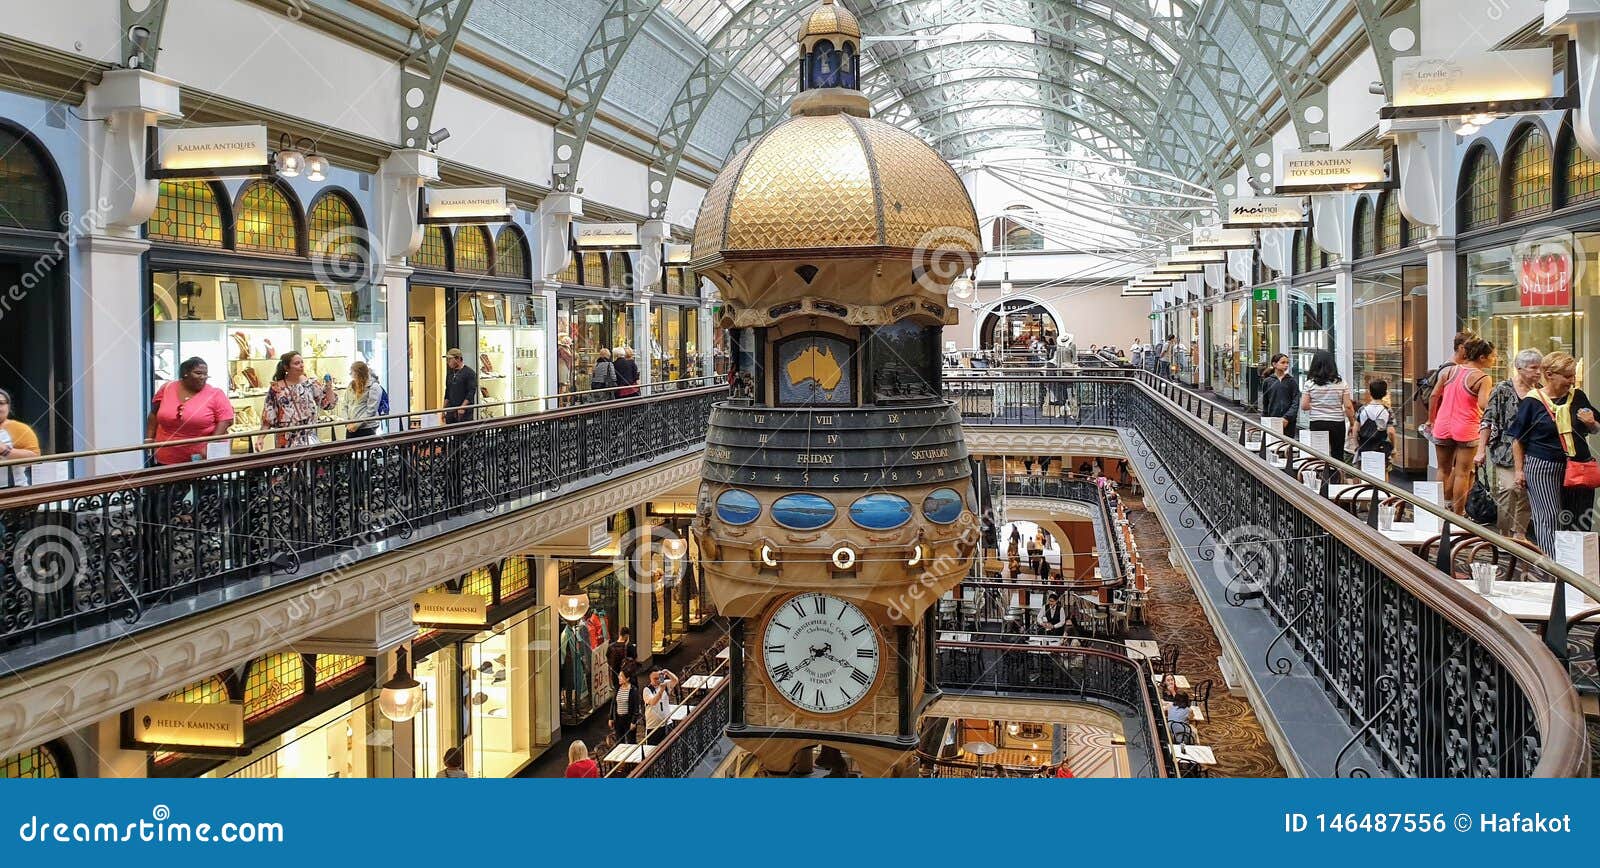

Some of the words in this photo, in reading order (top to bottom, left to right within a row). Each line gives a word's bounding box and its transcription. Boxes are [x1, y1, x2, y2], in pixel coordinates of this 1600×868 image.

[1417, 69, 1448, 79] Lovelle
[177, 144, 212, 153] KALMAR
[212, 141, 256, 151] ANTIQUES
[1289, 159, 1315, 168] PETER
[1315, 158, 1352, 167] NATHAN
[1290, 169, 1308, 177] TOY
[1309, 167, 1351, 176] SOLDIERS
[1522, 271, 1567, 294] SALE
[754, 415, 765, 424] VII
[815, 415, 833, 425] VIII
[827, 434, 838, 443] IV
[797, 454, 834, 464] FRIDAY
[911, 448, 948, 460] SATURDAY
[750, 471, 757, 480] 3
[774, 473, 782, 482] 4
[832, 473, 840, 483] 6
[863, 472, 869, 482] 7
[891, 472, 898, 481] 8
[916, 470, 923, 479] 9
[424, 604, 445, 612] HELEN
[446, 606, 477, 614] KAMINSKI
[857, 648, 874, 659] III
[157, 719, 185, 729] HELEN
[187, 721, 230, 732] KAMINSKI
